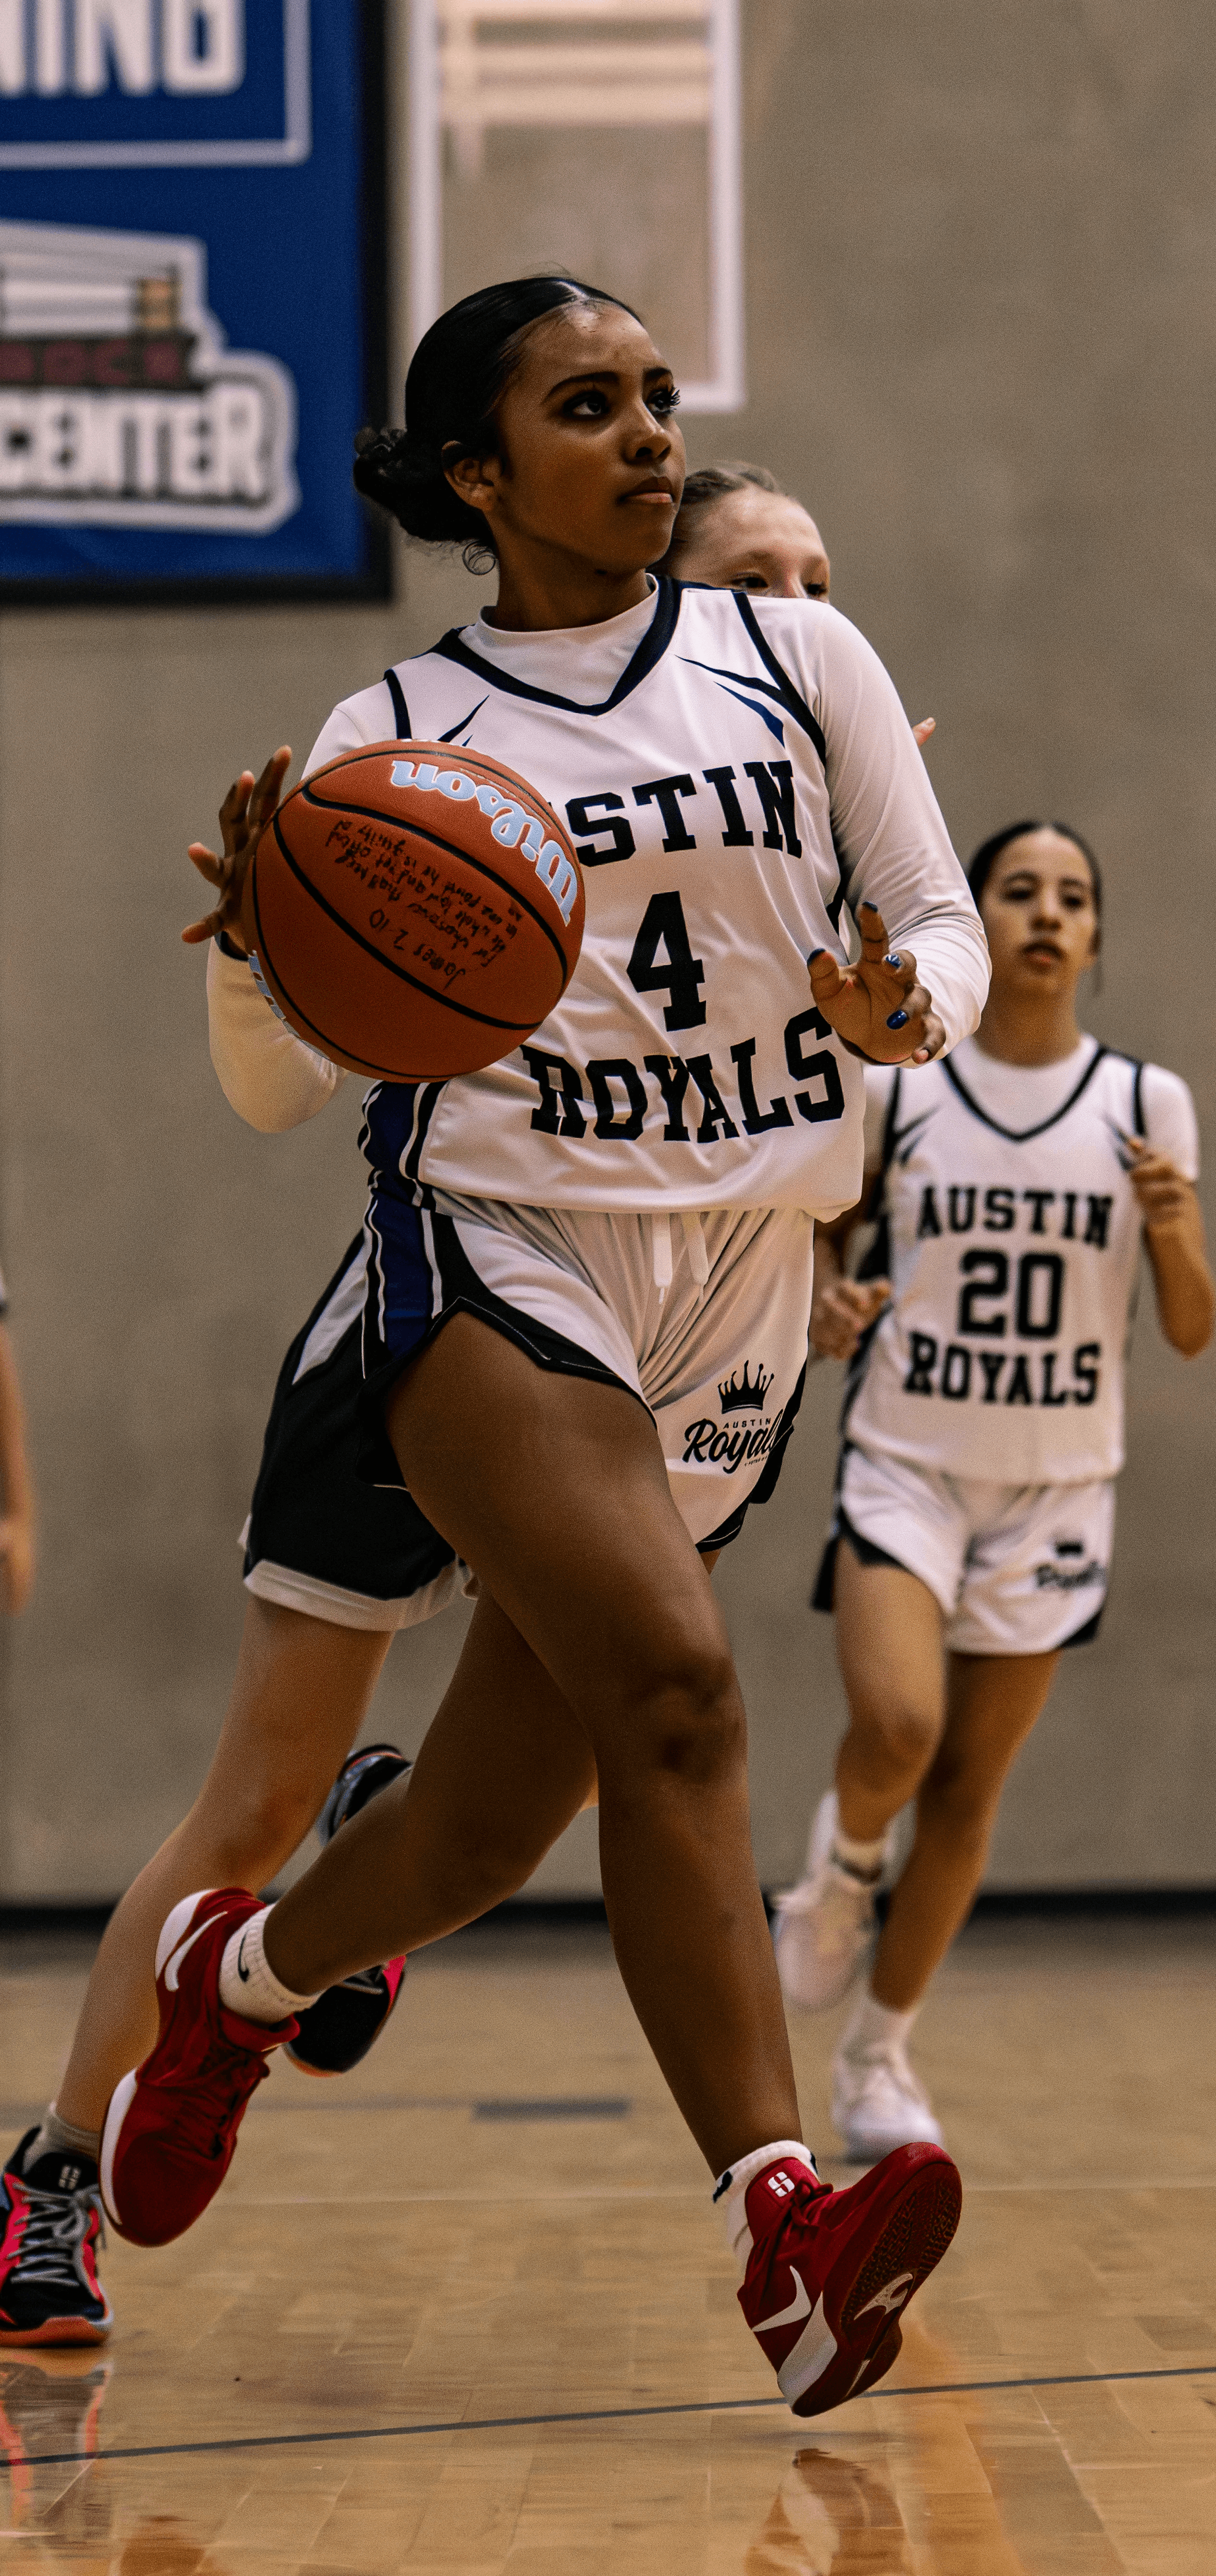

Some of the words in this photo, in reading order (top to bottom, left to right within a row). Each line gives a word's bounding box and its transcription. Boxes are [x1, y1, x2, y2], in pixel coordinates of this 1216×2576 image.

[0, 0, 246, 96] ING
[390, 760, 578, 927] Wilson
[564, 759, 802, 867] STIN
[396, 870, 426, 893] and
[404, 856, 417, 868] is
[422, 865, 439, 886] he
[412, 943, 466, 991] James
[626, 890, 707, 1032] 4
[520, 1007, 845, 1143] ROYALS
[916, 1185, 1113, 1251] AUSTIN
[958, 1249, 1065, 1339] 20
[903, 1331, 1101, 1406] ROYALS
[682, 1408, 784, 1474] Royal
[723, 1418, 771, 1429] AUSTIN
